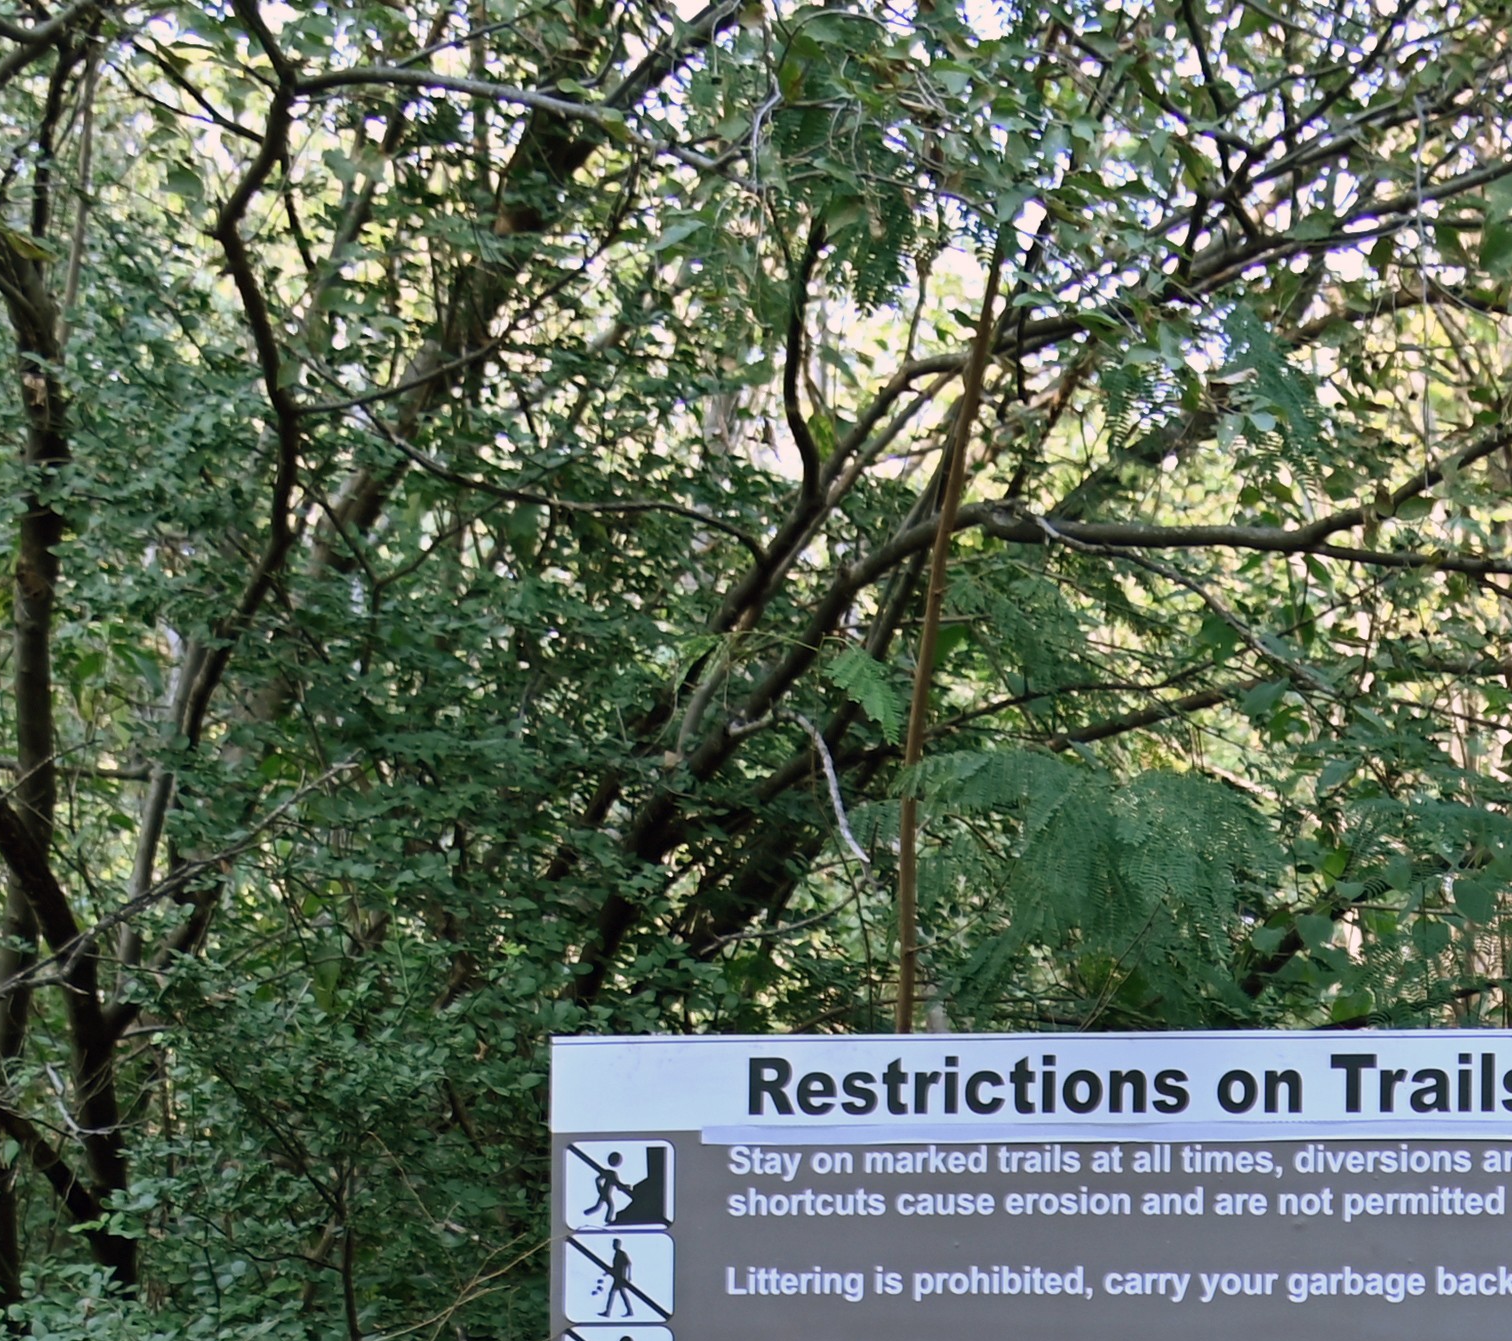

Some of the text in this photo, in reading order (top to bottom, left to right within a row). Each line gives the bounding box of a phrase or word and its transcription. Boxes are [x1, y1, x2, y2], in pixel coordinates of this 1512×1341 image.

[747, 1052, 1191, 1118] Restrictions
[1215, 1067, 1303, 1115] on
[728, 1144, 802, 1183] Stay
[811, 1151, 853, 1175] on
[864, 1144, 988, 1175] marked
[997, 1143, 1081, 1174] trails
[1091, 1145, 1123, 1174] at
[1132, 1143, 1171, 1174] all
[1181, 1143, 1283, 1179] times,
[1294, 1143, 1472, 1174] diversions
[728, 1185, 1505, 1223] shortcuts cause erosion and are not permitted
